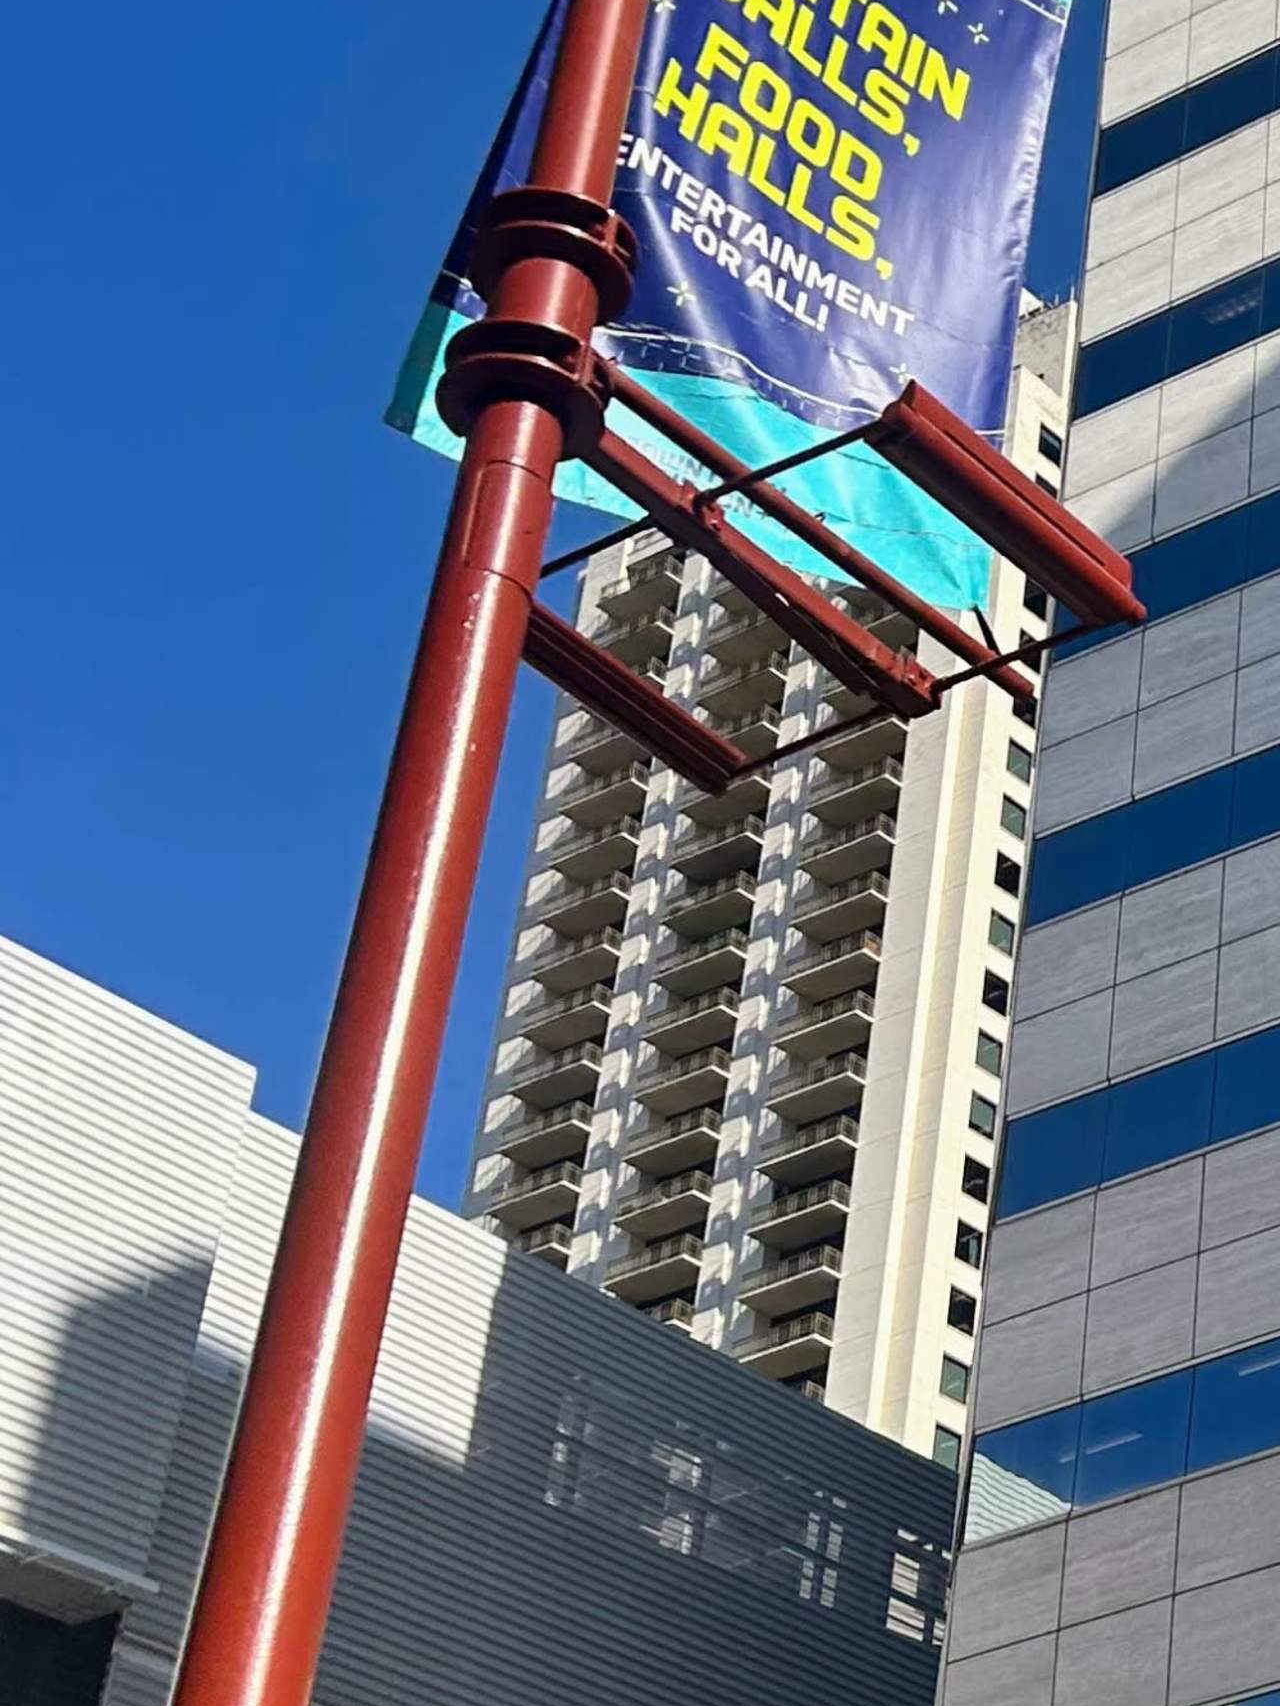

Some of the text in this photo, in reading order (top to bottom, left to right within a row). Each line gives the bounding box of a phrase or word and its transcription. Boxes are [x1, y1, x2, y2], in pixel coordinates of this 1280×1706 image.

[653, 57, 894, 281] HALLS,
[695, 22, 883, 202] FOOD
[671, 206, 829, 333] FOR ALL!
